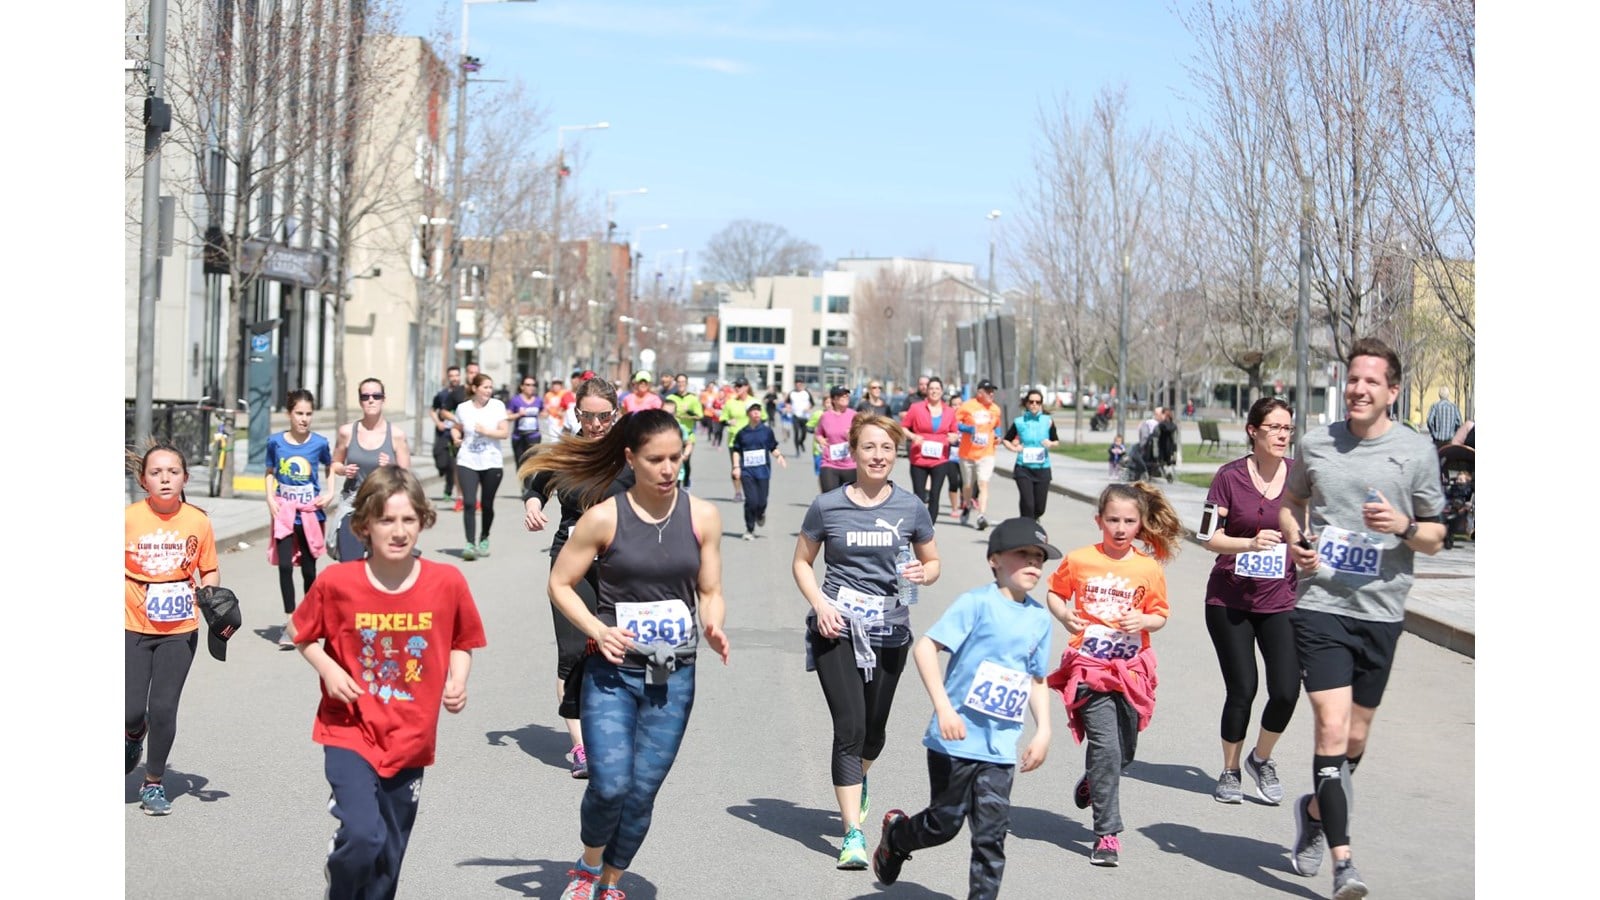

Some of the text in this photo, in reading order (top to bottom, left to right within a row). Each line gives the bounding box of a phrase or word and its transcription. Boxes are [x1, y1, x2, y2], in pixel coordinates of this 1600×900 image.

[846, 531, 893, 547] PUMA
[1237, 553, 1283, 573] 4395
[1321, 541, 1378, 568] 4309
[1084, 585, 1099, 593] CLUB
[1107, 588, 1131, 599] COURSE
[147, 594, 193, 614] 4498
[355, 612, 433, 631] PIXELS
[626, 617, 688, 643] 4361
[1083, 637, 1139, 661] 4253
[973, 680, 1028, 713] 4362
